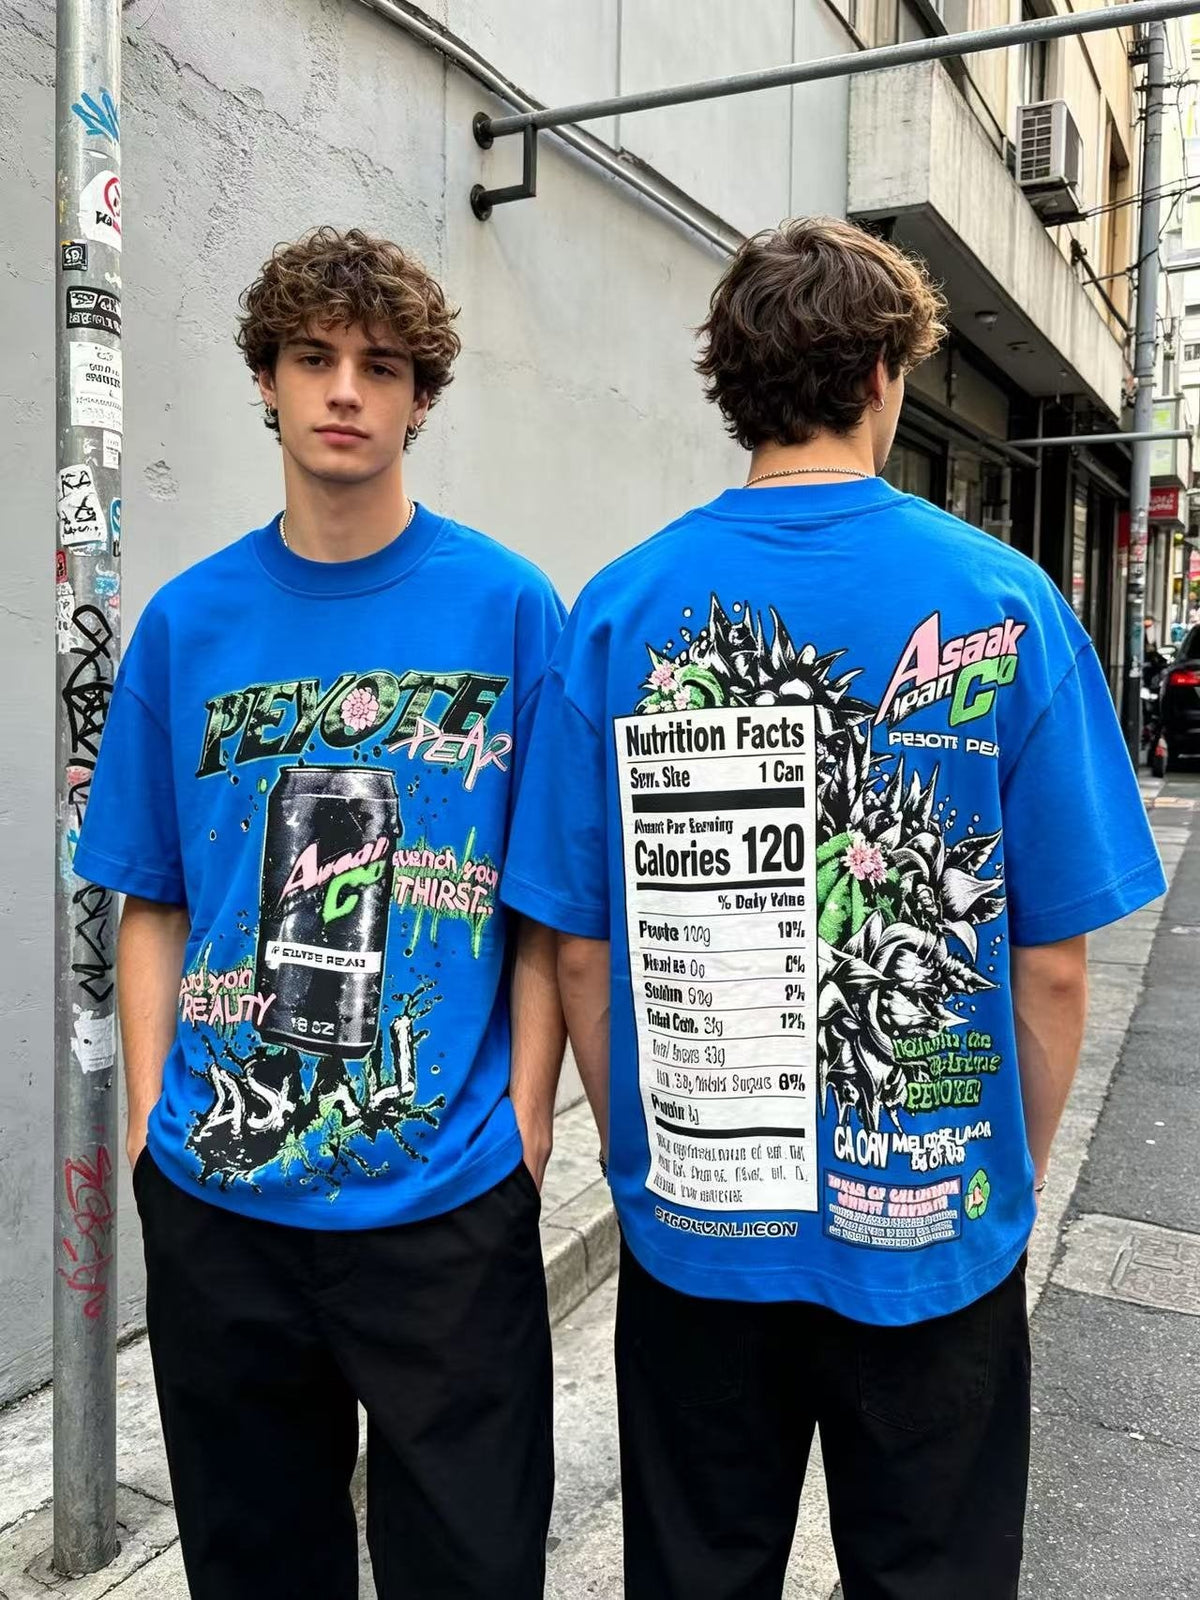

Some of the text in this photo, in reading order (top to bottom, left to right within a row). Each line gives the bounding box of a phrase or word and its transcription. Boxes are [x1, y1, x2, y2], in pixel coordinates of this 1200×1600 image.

[873, 612, 1026, 727] Asaak
[195, 671, 510, 778] PEYOTE
[625, 716, 805, 757] Nutrition Facts
[759, 761, 766, 783] 1
[774, 760, 804, 782] Can
[634, 823, 805, 878] Calories 120
